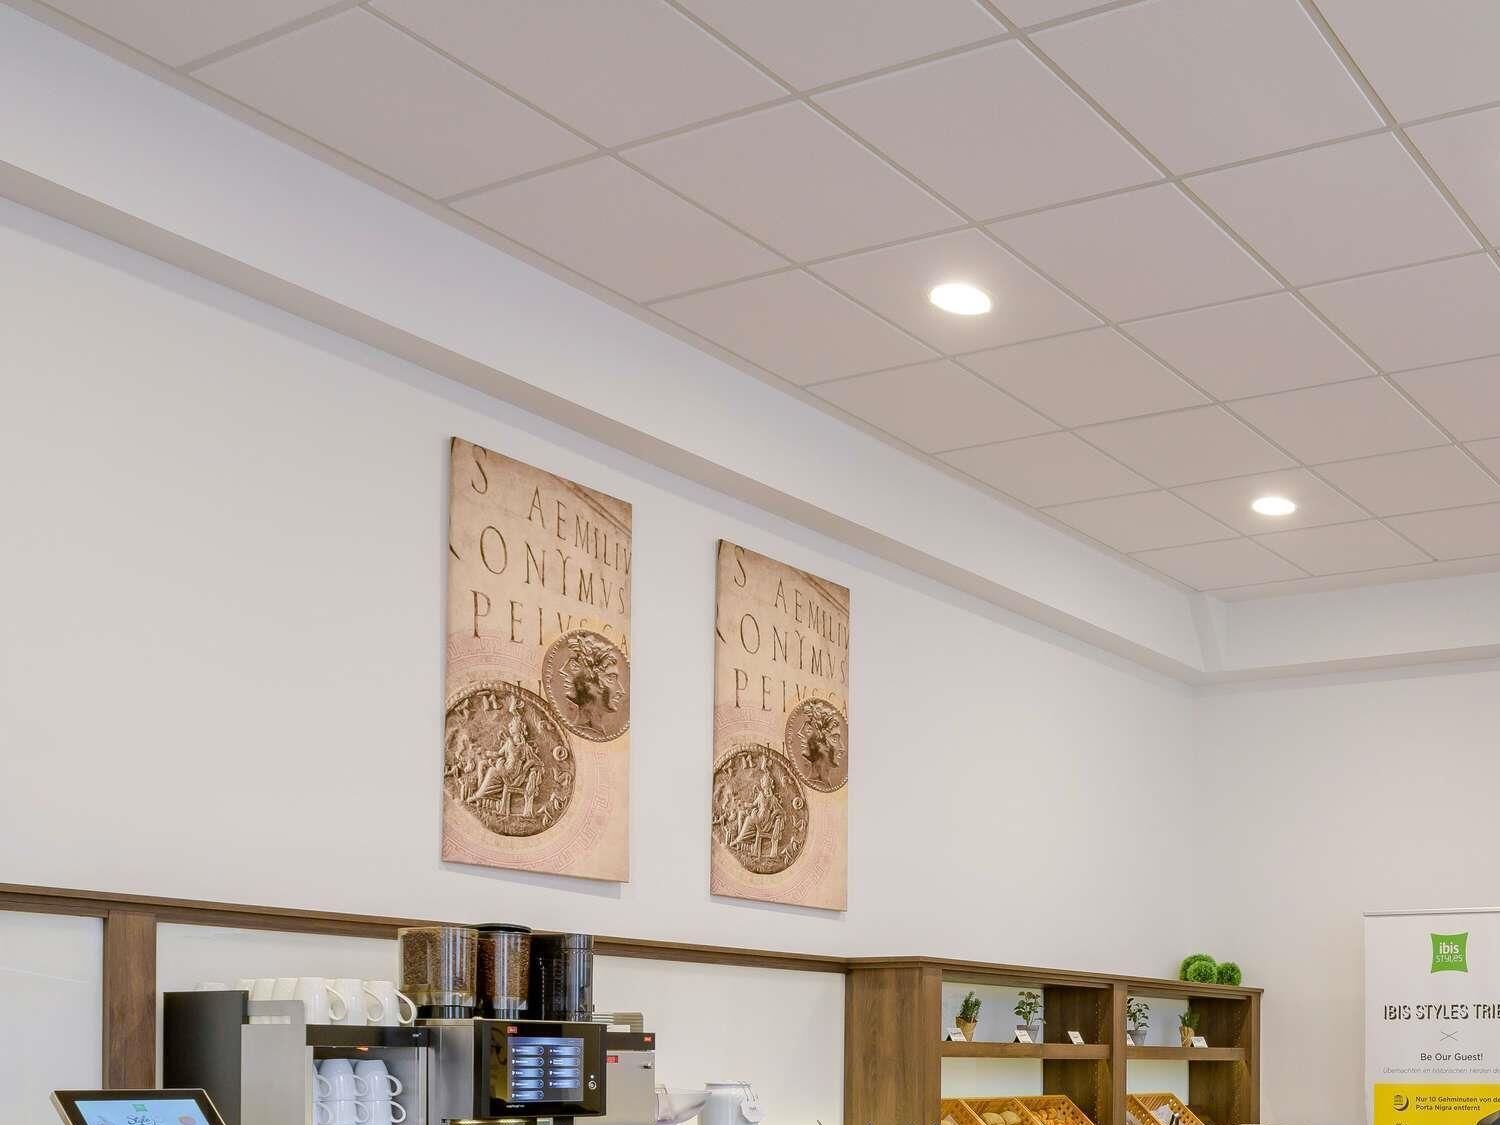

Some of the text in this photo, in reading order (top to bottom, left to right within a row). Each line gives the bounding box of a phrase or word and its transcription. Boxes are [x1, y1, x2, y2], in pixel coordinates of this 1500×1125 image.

[449, 525, 625, 615] ONYMVS
[1439, 942, 1459, 954] ibis
[1383, 1004, 1411, 1020] IBIS
[1415, 1004, 1469, 1020] STYLES
[1420, 1052, 1483, 1061] Be Our Guest!
